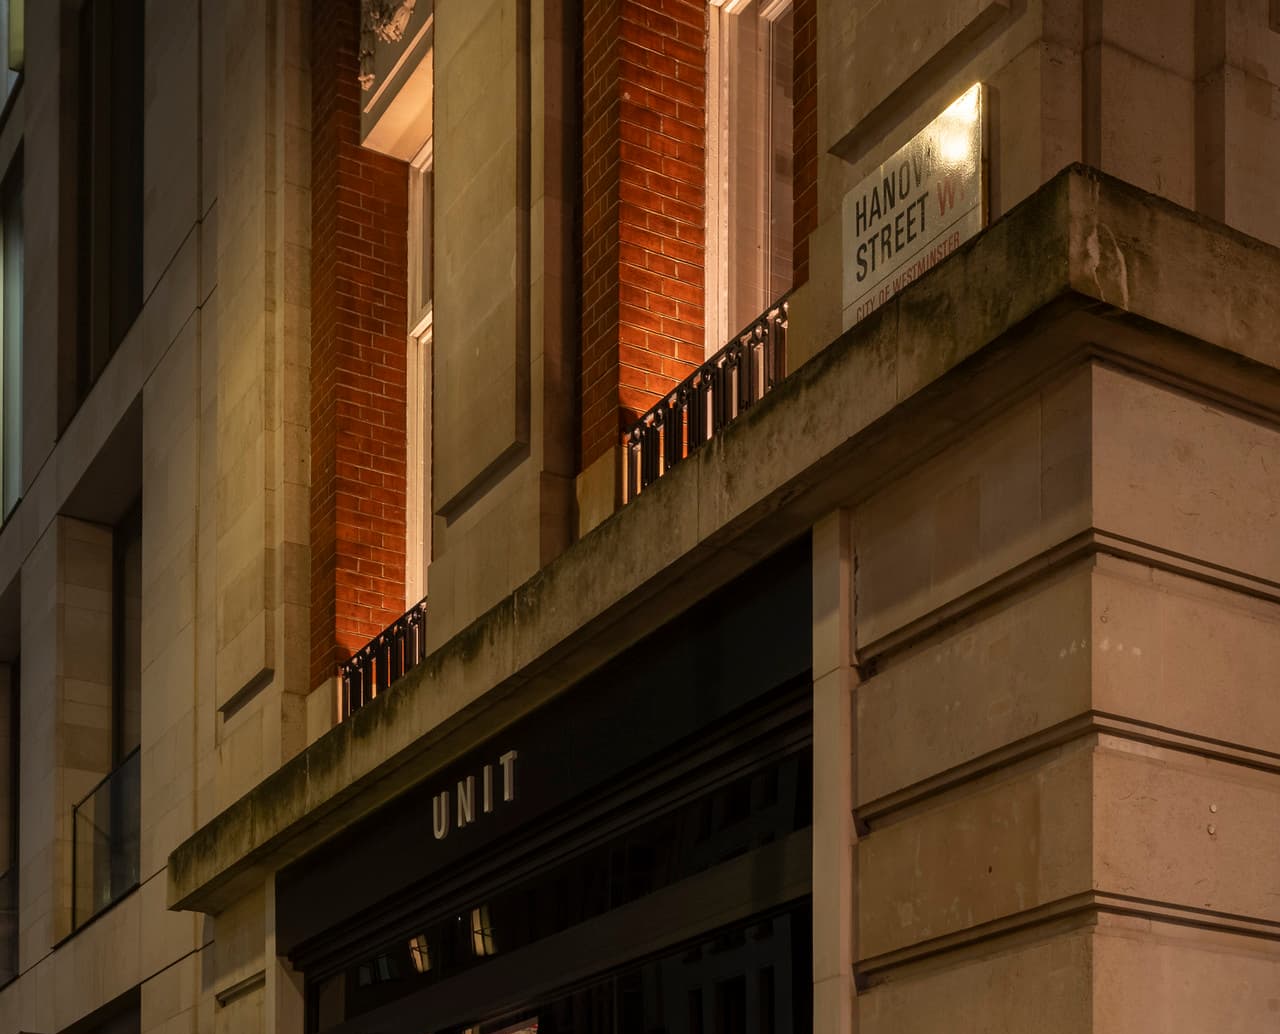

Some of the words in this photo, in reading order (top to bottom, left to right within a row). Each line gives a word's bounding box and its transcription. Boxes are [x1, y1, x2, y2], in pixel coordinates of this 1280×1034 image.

[855, 136, 935, 238] HANOV
[856, 190, 929, 282] STREET
[893, 231, 960, 293] WESTMINSTER
[432, 750, 518, 840] UNIT
